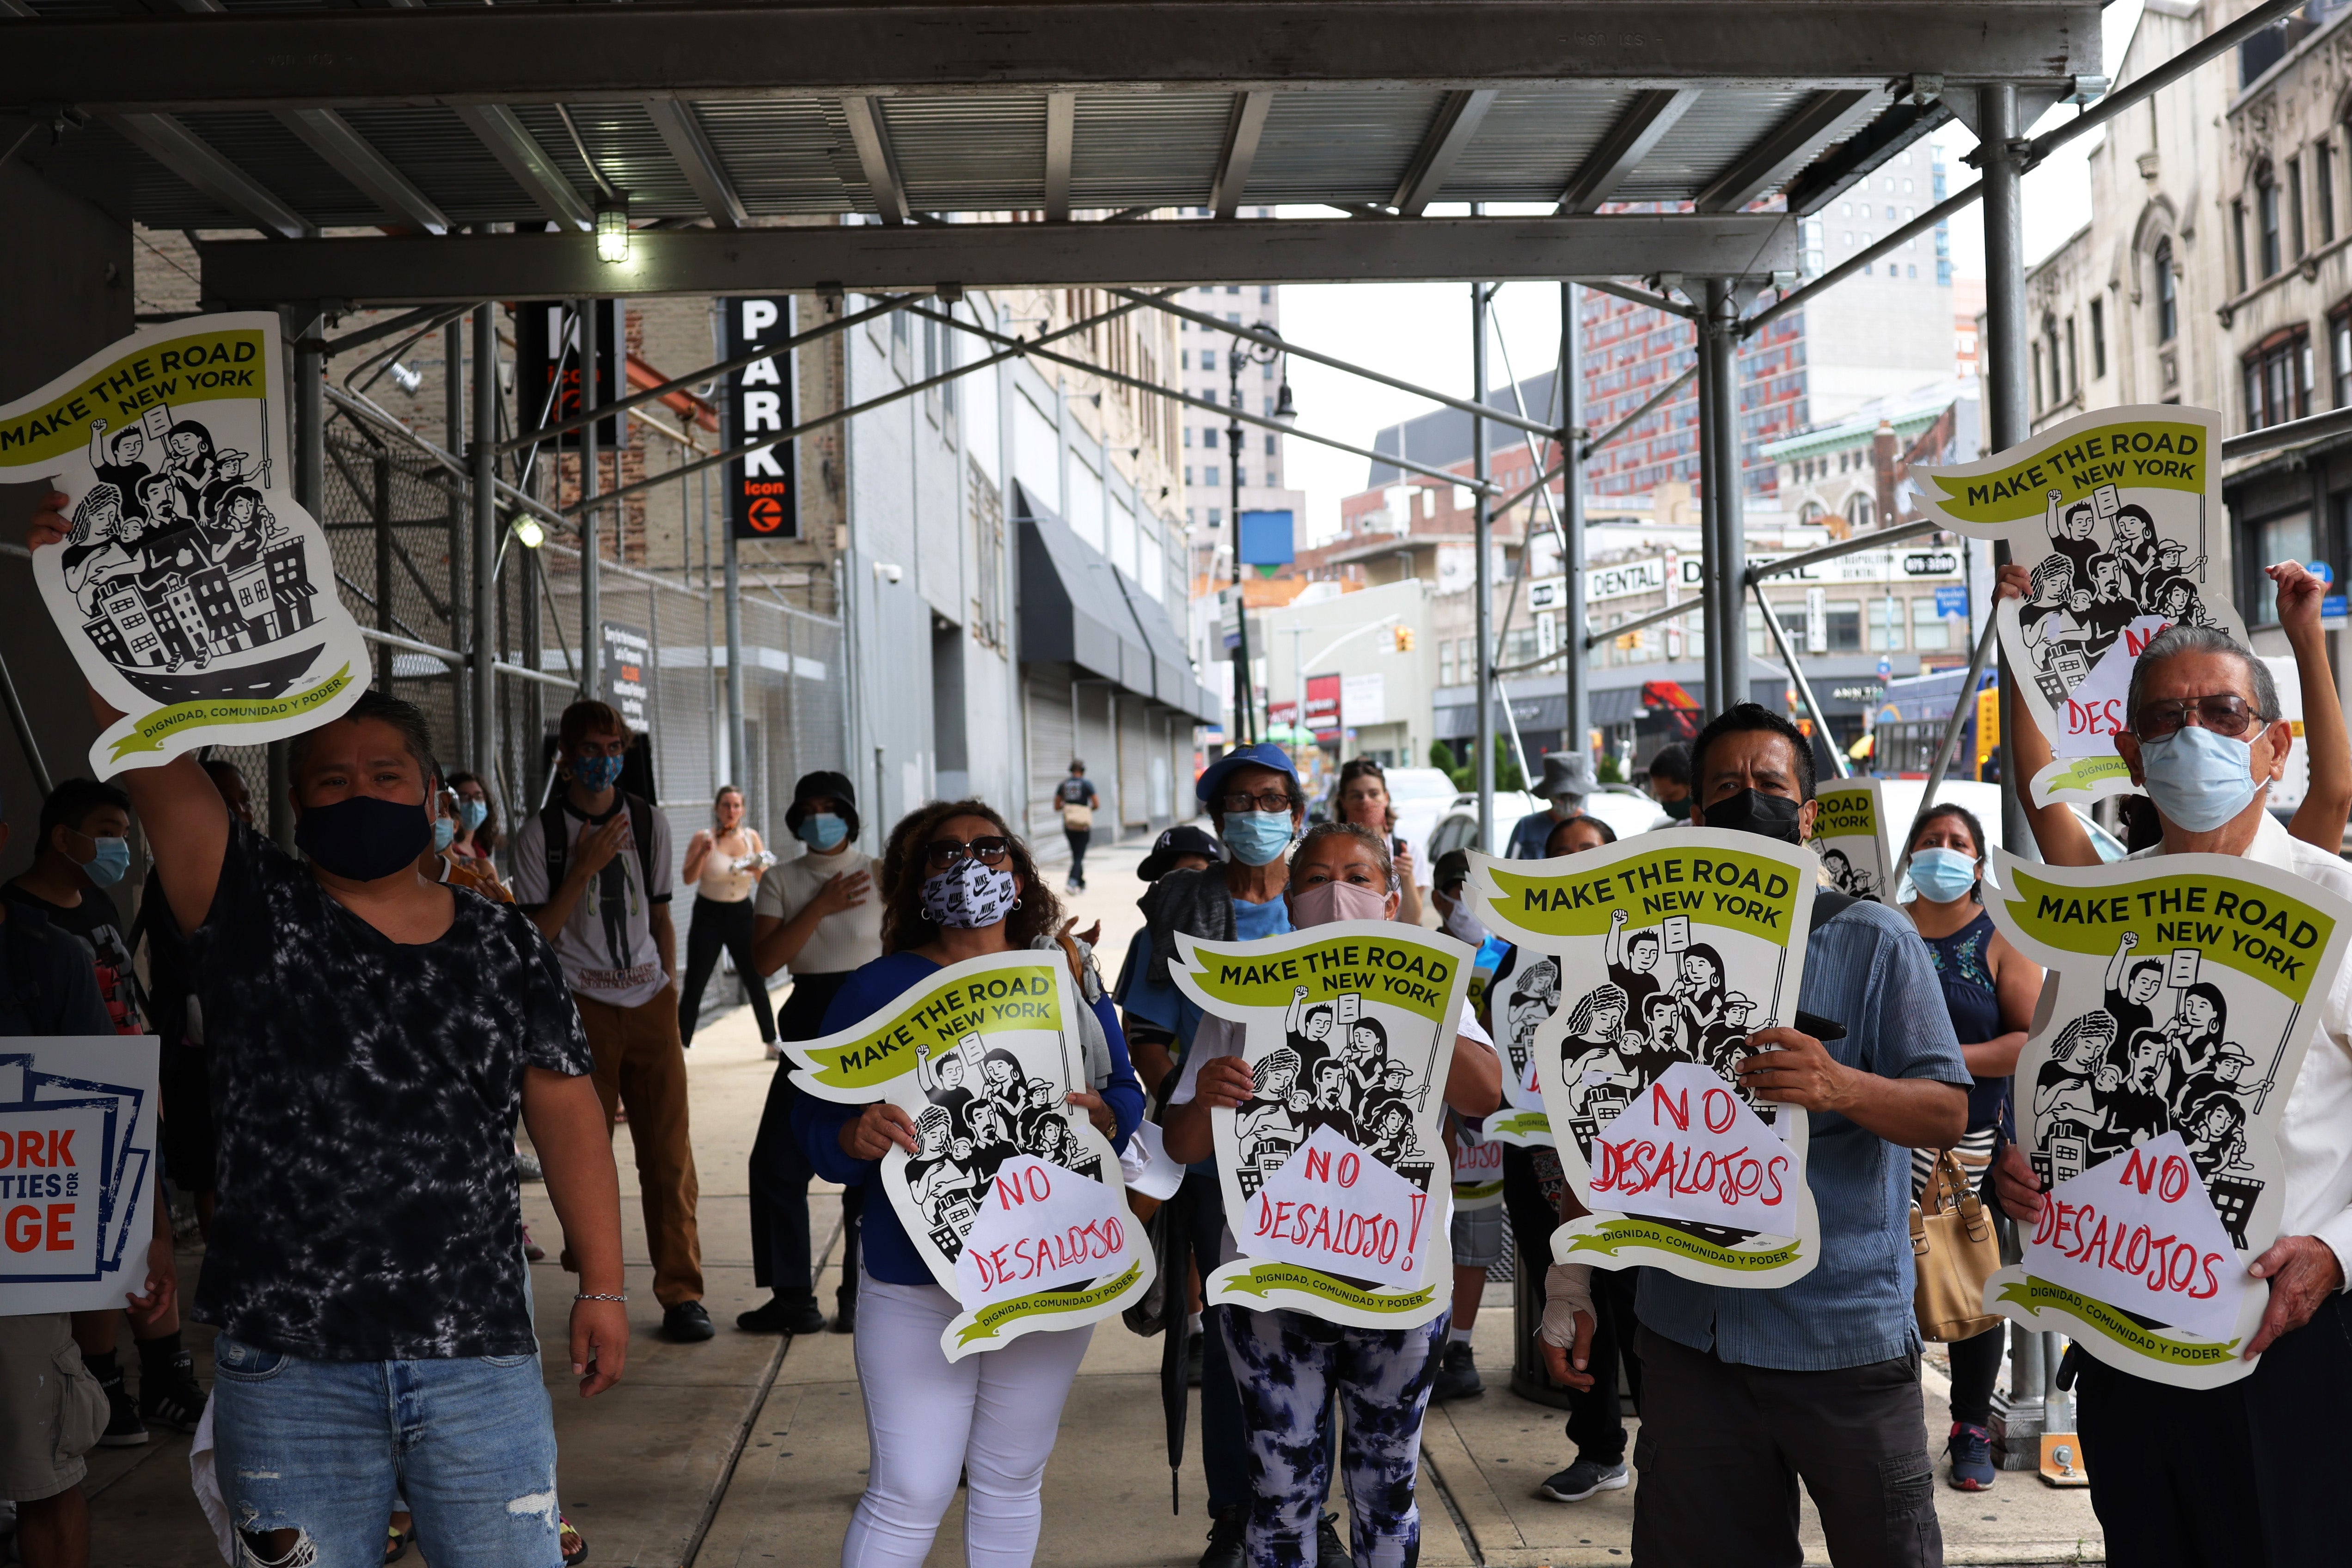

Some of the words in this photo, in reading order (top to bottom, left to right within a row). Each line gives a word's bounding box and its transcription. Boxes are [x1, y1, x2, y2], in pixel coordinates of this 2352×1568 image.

[0, 397, 91, 451] MAKE
[88, 358, 155, 403] THE
[161, 342, 255, 373] ROAD
[118, 377, 177, 416] NEW
[185, 370, 255, 390] YORK
[741, 300, 784, 477] PARK
[744, 481, 784, 495] icon
[1968, 465, 2047, 506] MAKE
[2046, 437, 2105, 474] THE
[2112, 433, 2198, 455] ROAD
[2072, 460, 2125, 490] NEW
[2133, 459, 2196, 480] YORK
[1594, 565, 1660, 595] DENTAL
[143, 708, 207, 739] DIGNIDAD,
[211, 704, 287, 717] COMUNIDAD
[290, 700, 298, 708] Y
[302, 679, 342, 705] PODER
[1830, 815, 1869, 828] YORK
[930, 881, 942, 891] NIKE
[949, 892, 962, 904] NIKE
[974, 874, 988, 887] NIKE
[1000, 879, 1011, 893] NIKE
[1525, 878, 1615, 911] MAKE
[1617, 859, 1683, 894] THE
[1693, 859, 1788, 898] ROAD
[980, 900, 996, 915] NIKE
[1643, 891, 1704, 915] NEW
[1713, 892, 1782, 928] YORK
[2037, 895, 2129, 924] MAKE
[2137, 887, 2207, 917] THE
[2214, 891, 2318, 951] ROAD
[1220, 959, 1298, 985] MAKE
[1303, 946, 1359, 973] THE
[1367, 947, 1447, 982] ROAD
[2157, 922, 2224, 944] NEW
[2233, 930, 2305, 981] YORK
[1323, 973, 1376, 991] NEW
[1383, 975, 1441, 1007] YORK
[840, 1027, 914, 1073] MAKE
[911, 990, 967, 1033] THE
[968, 978, 1048, 1004] ROAD
[936, 1009, 985, 1041] NEW
[991, 1003, 1050, 1019] YORK
[1654, 1083, 1736, 1134] NO
[66, 1172, 79, 1197] FOR
[996, 1166, 1050, 1210] NO
[1305, 1147, 1360, 1188] NO
[1590, 1138, 1788, 1206] DESALOJOS
[2119, 1149, 2189, 1203] NO
[969, 1217, 1123, 1292] DESALOJO
[1603, 1230, 1661, 1243] DIGNIDAD,
[1666, 1236, 1734, 1263] COMUNIDAD
[1750, 1252, 1788, 1265] PODER
[2031, 1191, 2224, 1300] DESALOJOS
[983, 1302, 1032, 1327] DIGNIDAD,
[1034, 1295, 1092, 1307] COMUNIDAD
[1104, 1274, 1134, 1298] PODER
[1256, 1274, 1309, 1286] DIGNIDAD,
[1313, 1280, 1374, 1305] COMUNIDAD
[1388, 1295, 1423, 1307] PODER
[2030, 1287, 2083, 1310] DIGNIDAD,
[2086, 1305, 2156, 1350] COMUNIDAD
[2160, 1343, 2168, 1354] Y
[2172, 1347, 2220, 1359] PODER
